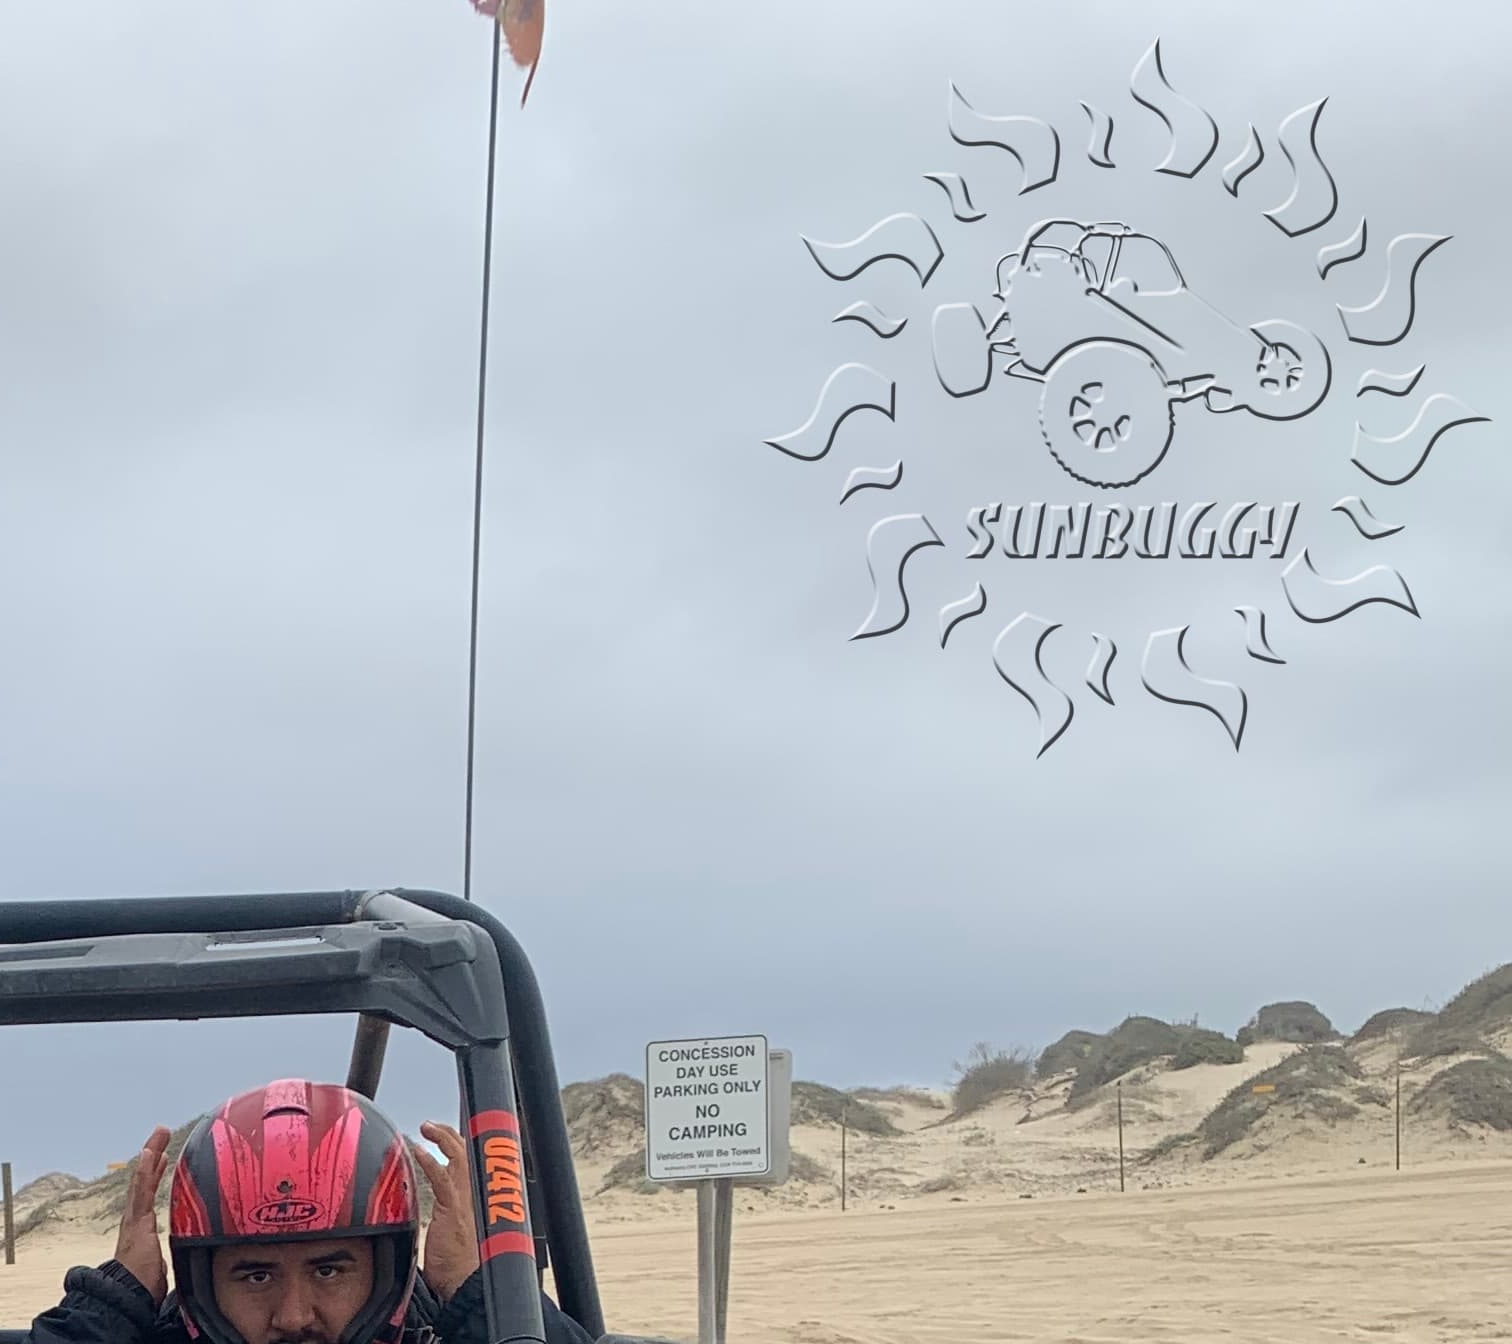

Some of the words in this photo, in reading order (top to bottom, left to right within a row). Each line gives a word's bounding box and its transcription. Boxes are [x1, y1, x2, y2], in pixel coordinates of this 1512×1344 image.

[658, 1045, 756, 1062] CONCESSION
[676, 1066, 705, 1079] DAY
[709, 1064, 738, 1077] USE
[654, 1083, 719, 1098] PARKING
[723, 1080, 761, 1094] ONLY
[695, 1104, 720, 1119] NO
[668, 1123, 747, 1140] CAMPING
[656, 1152, 695, 1160] Vehicles
[696, 1149, 714, 1158] Will
[716, 1148, 729, 1157] Be
[731, 1147, 761, 1157] Towed
[483, 1136, 526, 1225] UZ412
[259, 1203, 314, 1220] HJC
